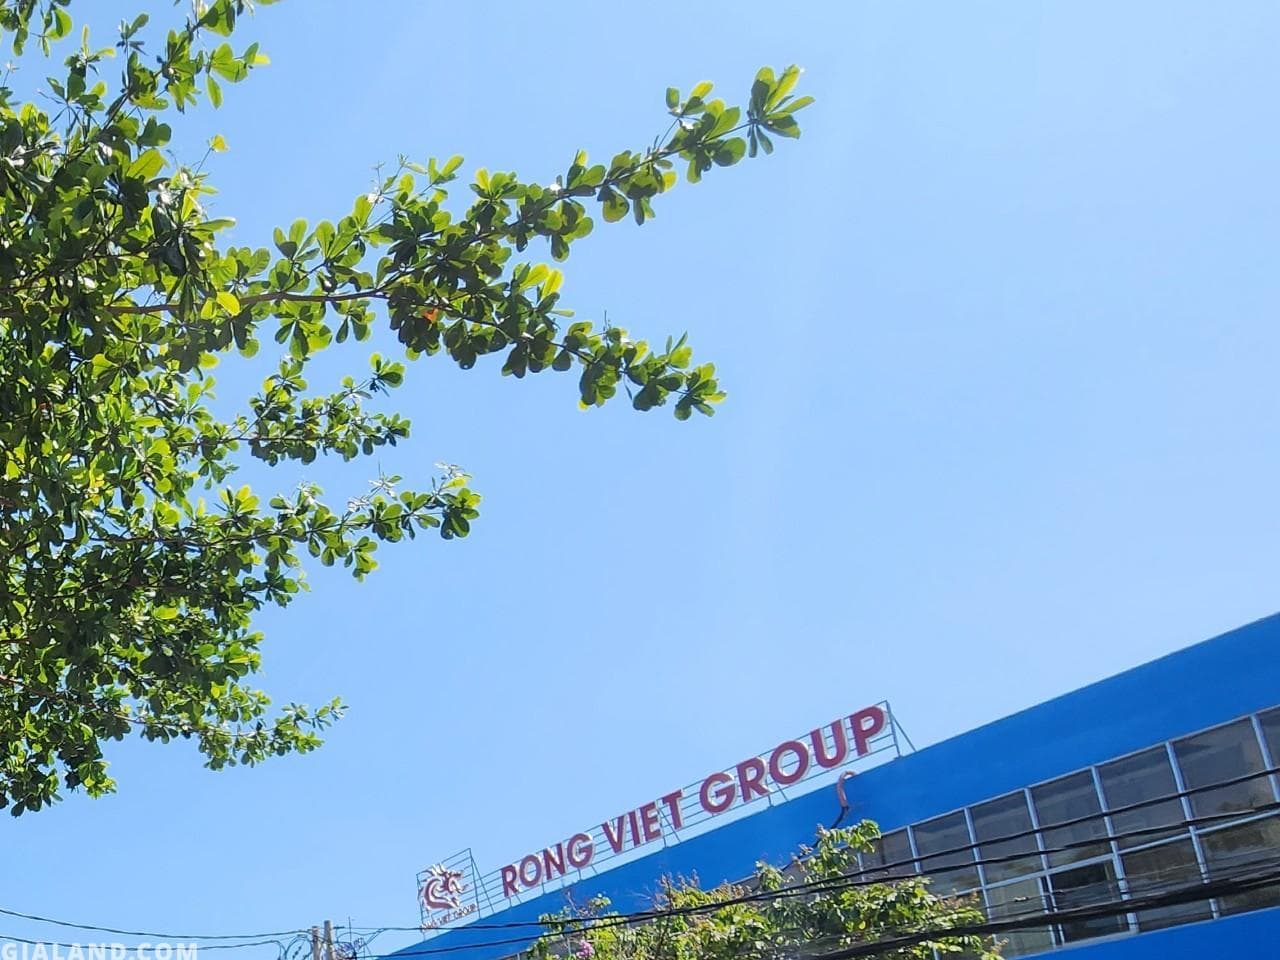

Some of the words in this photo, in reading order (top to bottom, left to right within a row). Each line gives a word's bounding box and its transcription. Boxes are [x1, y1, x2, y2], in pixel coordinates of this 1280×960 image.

[501, 832, 594, 898] RONG
[601, 789, 684, 855] VIET
[700, 705, 888, 815] GROUP
